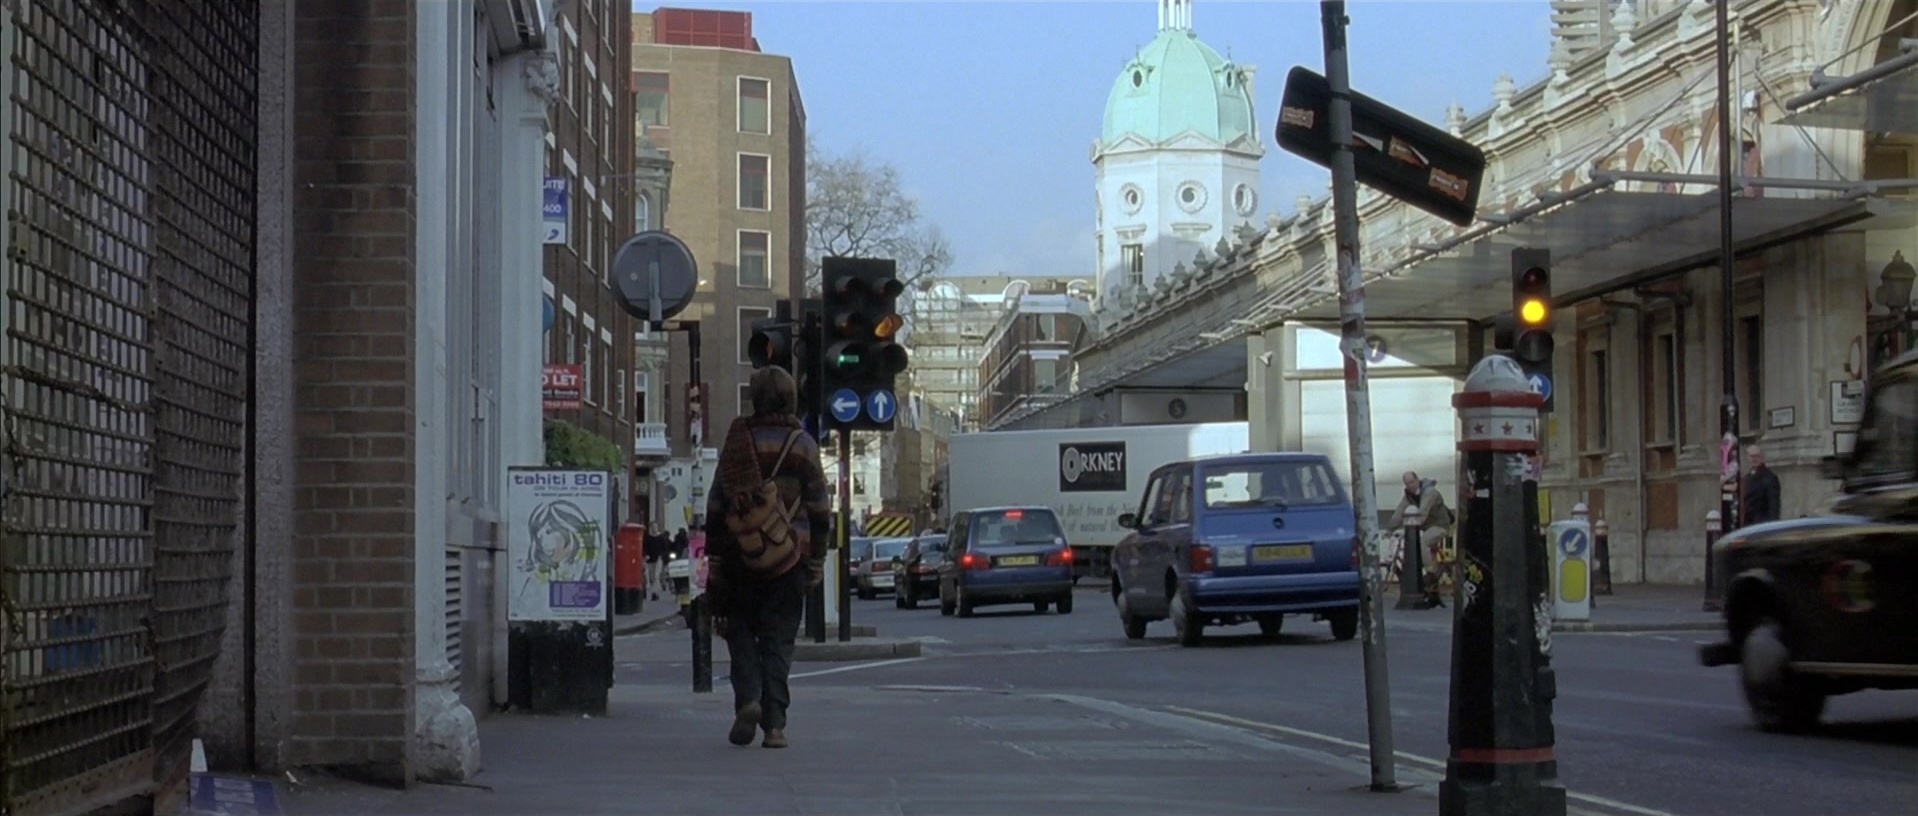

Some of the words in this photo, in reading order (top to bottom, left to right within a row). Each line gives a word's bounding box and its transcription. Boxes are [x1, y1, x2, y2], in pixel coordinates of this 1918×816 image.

[1369, 340, 1380, 358] 7
[552, 374, 578, 386] LET
[1062, 447, 1123, 483] ORKNEY
[514, 473, 566, 485] tahiti
[574, 473, 603, 486] 80
